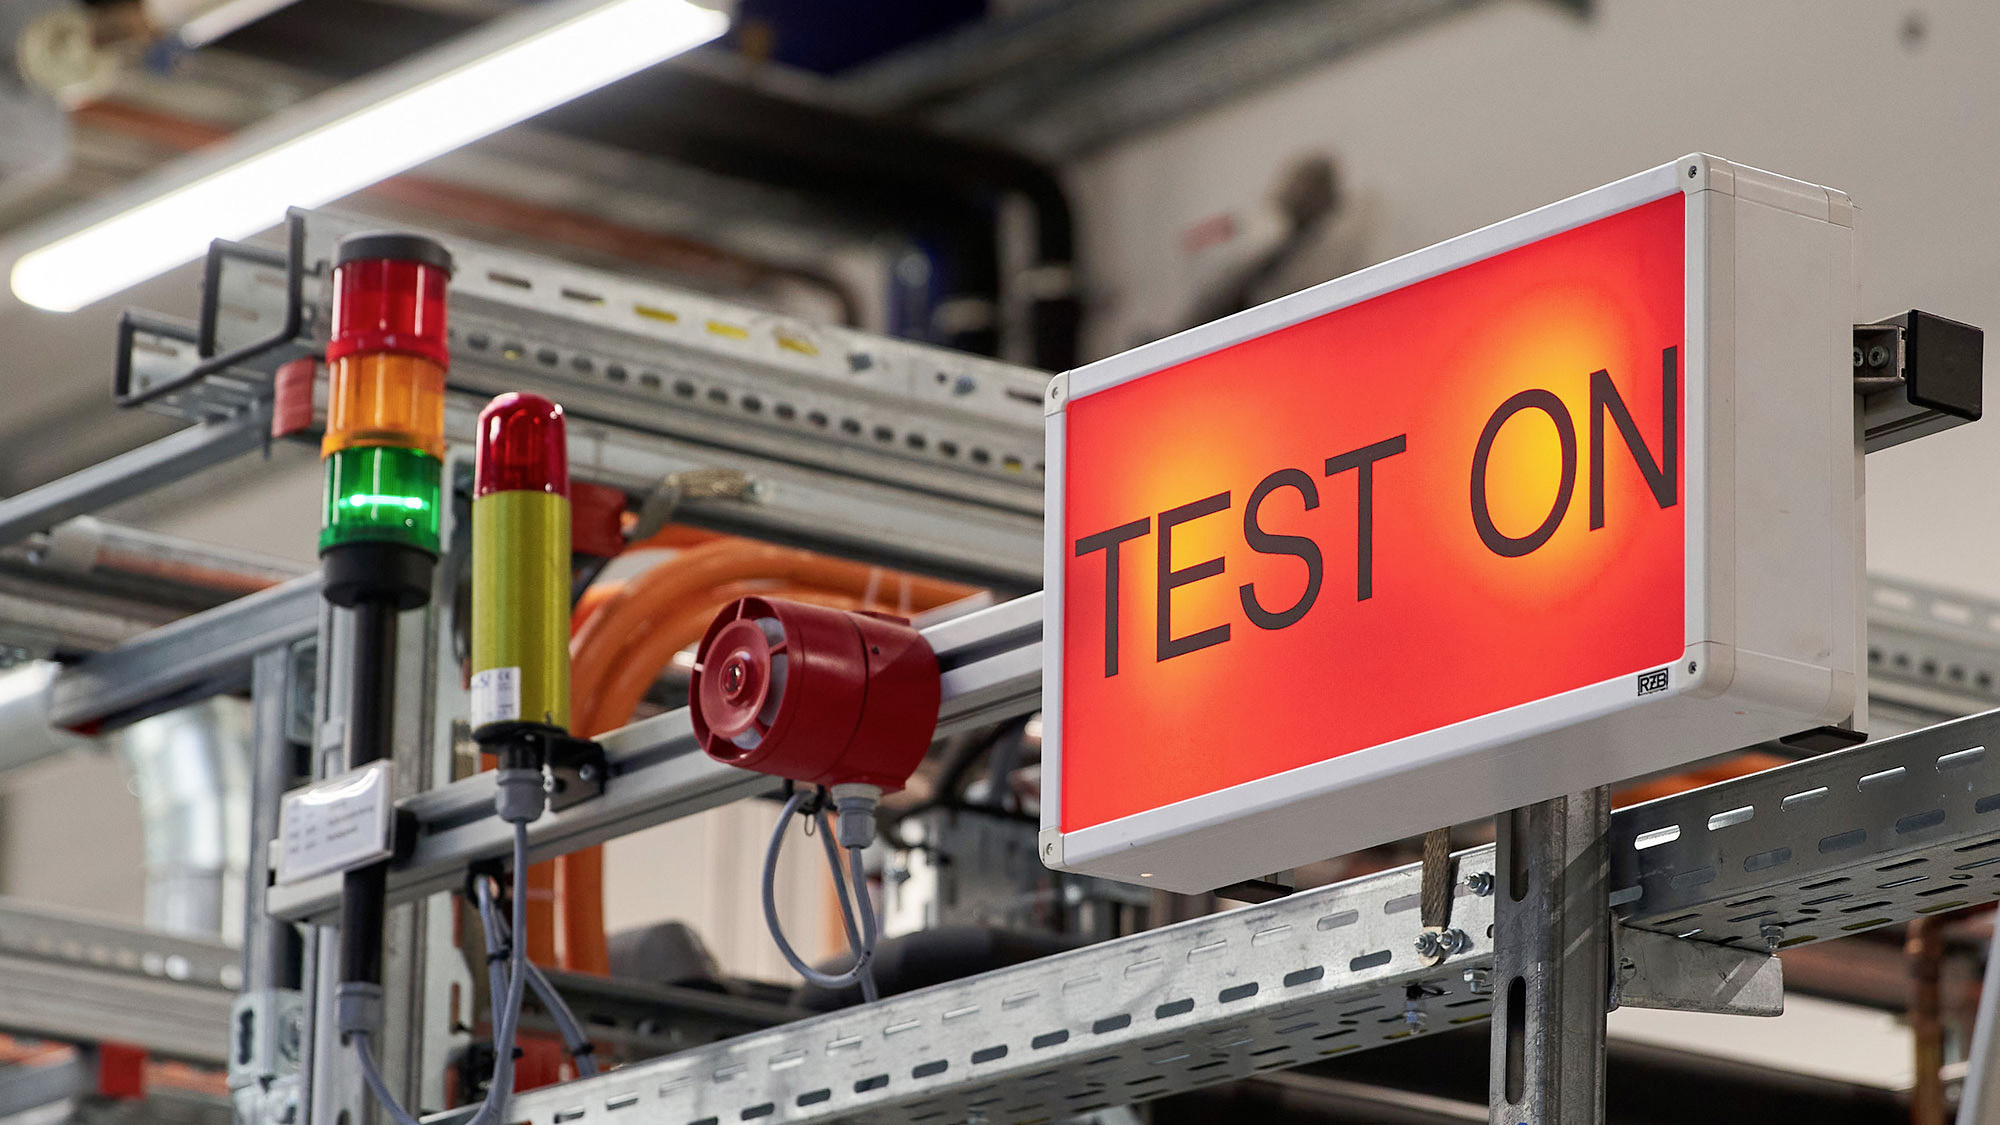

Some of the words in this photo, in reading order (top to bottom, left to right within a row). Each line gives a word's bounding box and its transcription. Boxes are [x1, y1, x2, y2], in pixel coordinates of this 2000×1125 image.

[1075, 433, 1407, 679] TEST
[1470, 345, 1678, 558] ON
[1640, 672, 1666, 693] RZB
